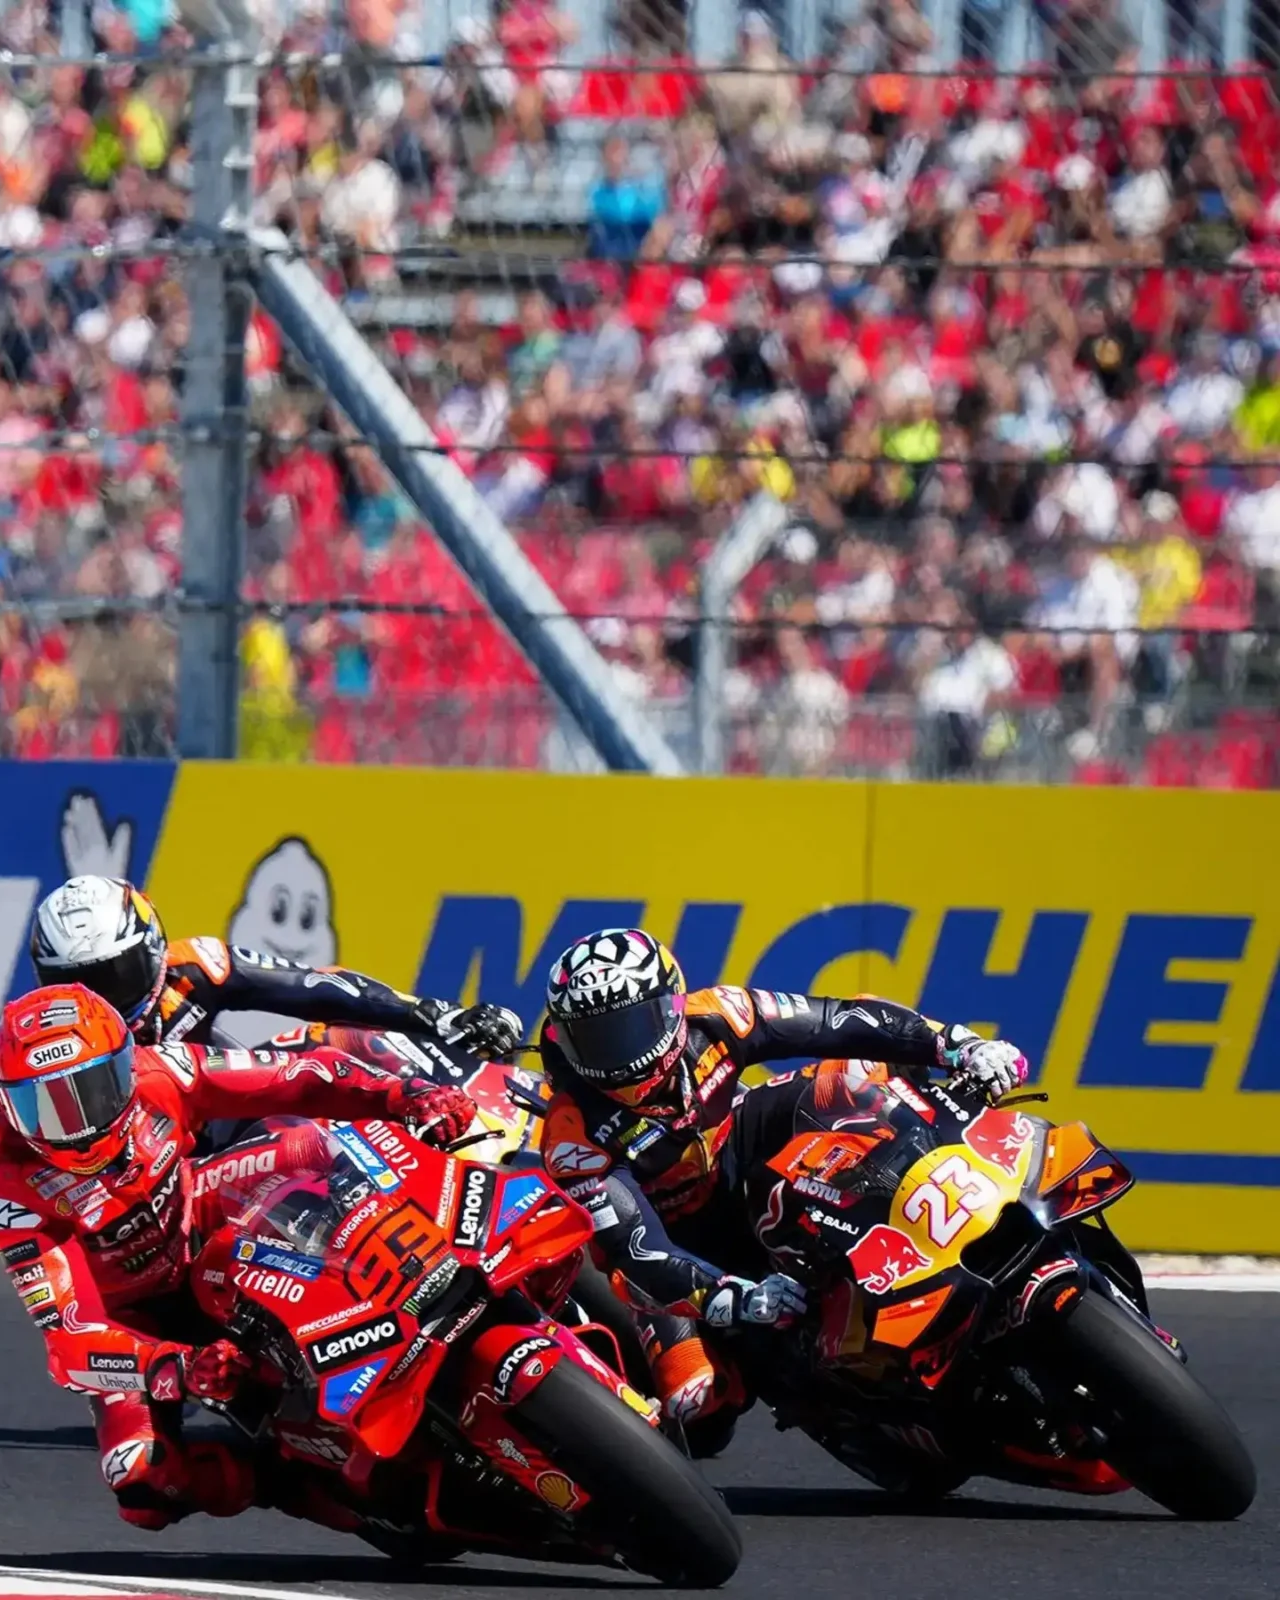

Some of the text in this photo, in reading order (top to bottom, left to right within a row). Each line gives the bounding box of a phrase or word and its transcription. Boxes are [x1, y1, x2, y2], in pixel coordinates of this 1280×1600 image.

[568, 966, 615, 991] KYT
[586, 1006, 607, 1017] YOU
[611, 992, 645, 1010] WINGS
[34, 1043, 74, 1066] SHOEI
[629, 1030, 674, 1071] TERRANOVA
[699, 1062, 734, 1102] MOTUL
[435, 1157, 457, 1229] FRECCIAROSSA
[453, 1169, 487, 1247] Lenovo
[514, 1186, 546, 1211] TIM
[793, 1175, 842, 1205] MOTUL
[902, 1154, 999, 1250] 23
[332, 1199, 379, 1250] VARGROUP
[822, 1215, 860, 1236] BAJAJ
[296, 1300, 374, 1336] FRECCIAROSSA
[311, 1320, 396, 1365] Lenovo
[388, 1335, 428, 1382] CARRERA
[90, 1355, 136, 1370] Lenovo
[493, 1337, 551, 1397] Lenovo
[97, 1374, 140, 1391] Unipol
[349, 1365, 377, 1397] TIM
